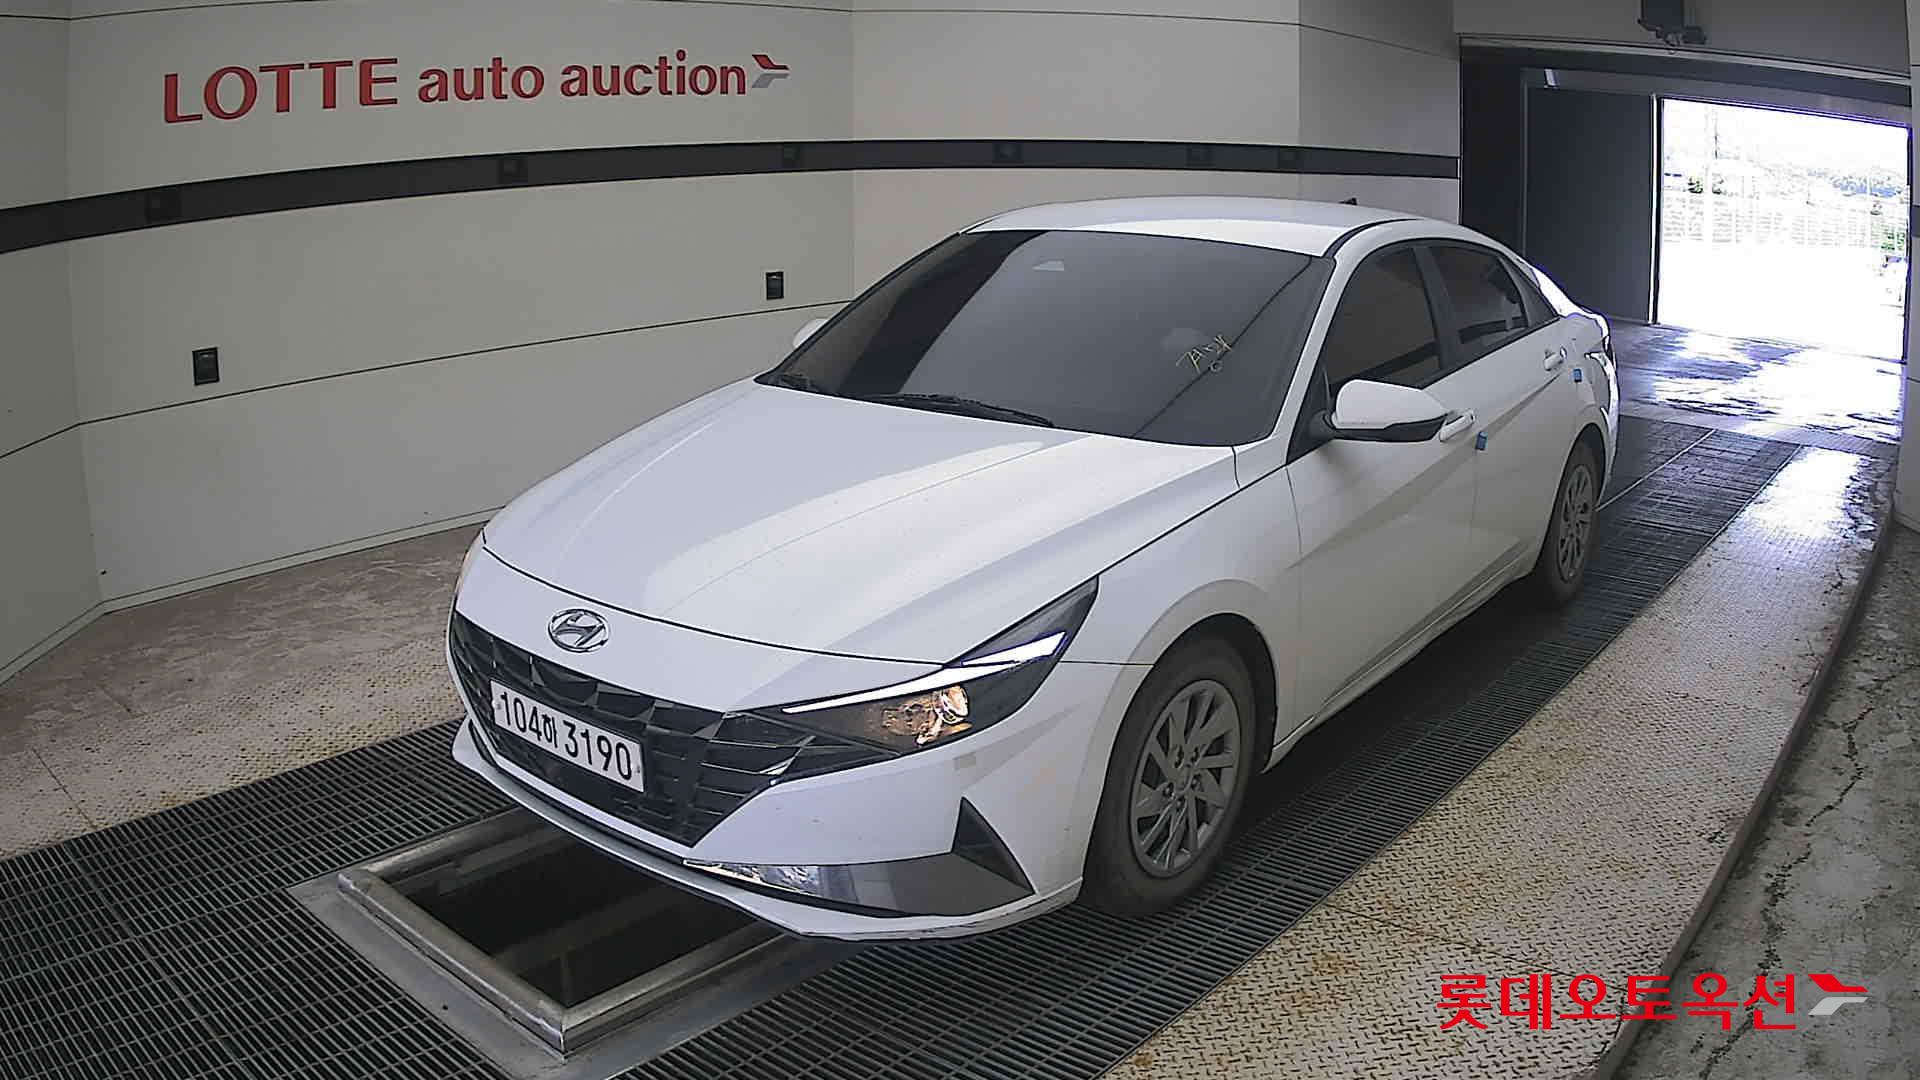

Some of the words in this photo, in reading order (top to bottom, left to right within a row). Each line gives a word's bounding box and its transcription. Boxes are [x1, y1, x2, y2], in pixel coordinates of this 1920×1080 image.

[164, 57, 398, 123] LOTTE
[418, 56, 544, 102] auto
[560, 49, 747, 96] auction
[500, 691, 558, 748] 104하
[562, 720, 632, 780] 3190
